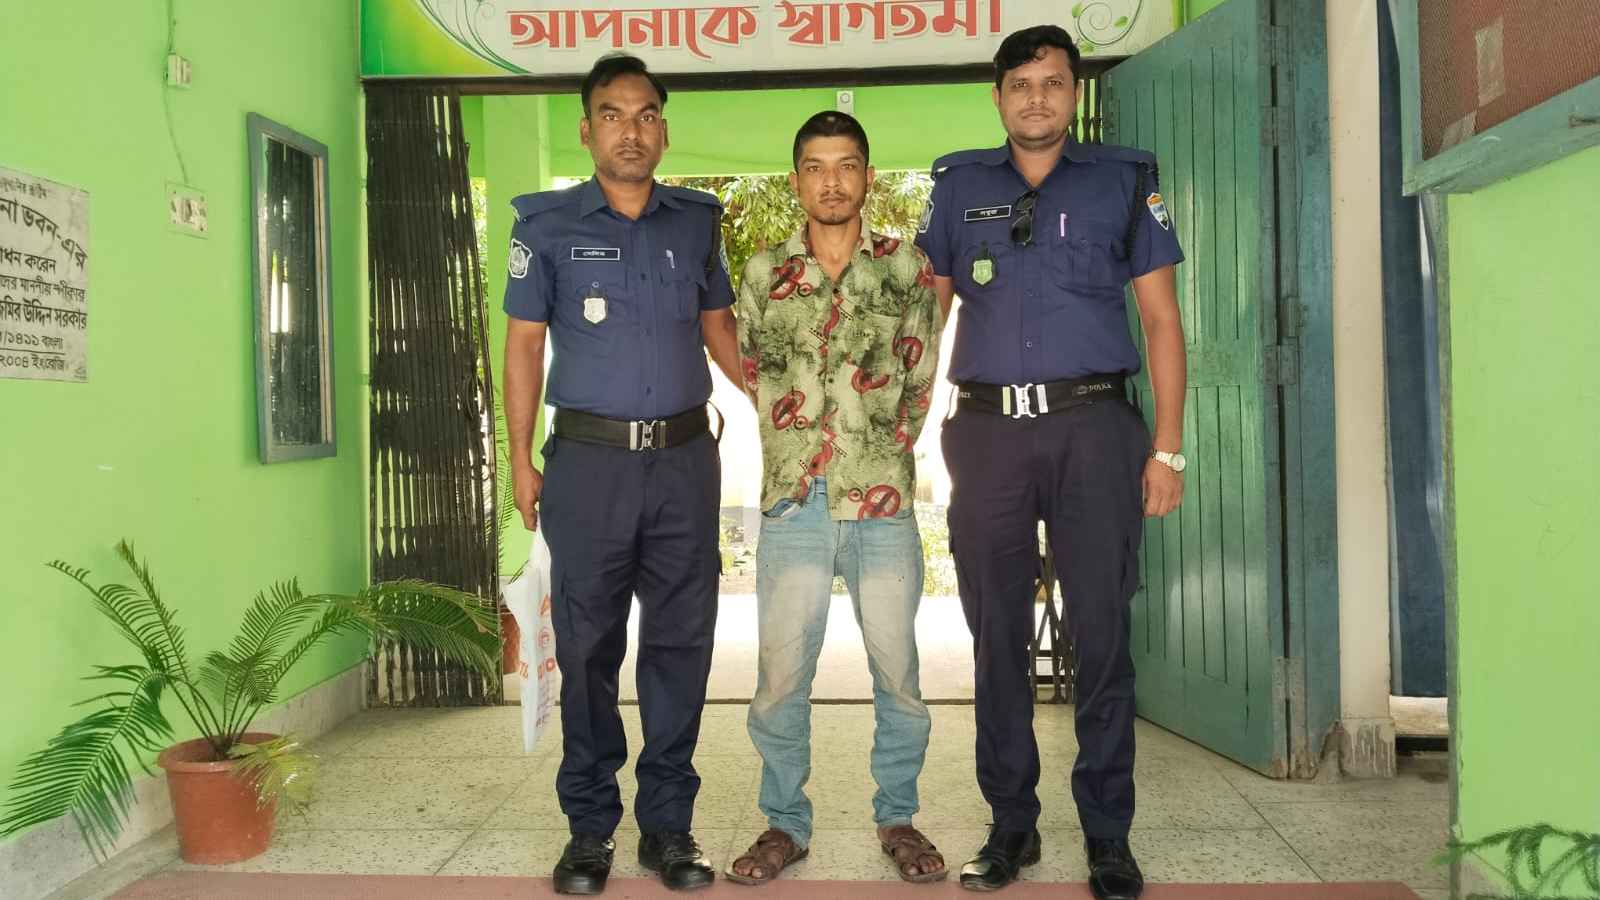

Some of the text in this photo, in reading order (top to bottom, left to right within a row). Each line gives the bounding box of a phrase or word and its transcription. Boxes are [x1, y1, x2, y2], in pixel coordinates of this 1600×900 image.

[506, 6, 759, 60] আপনাকে
[24, 253, 56, 274] করেন
[52, 308, 88, 330] সরকার
